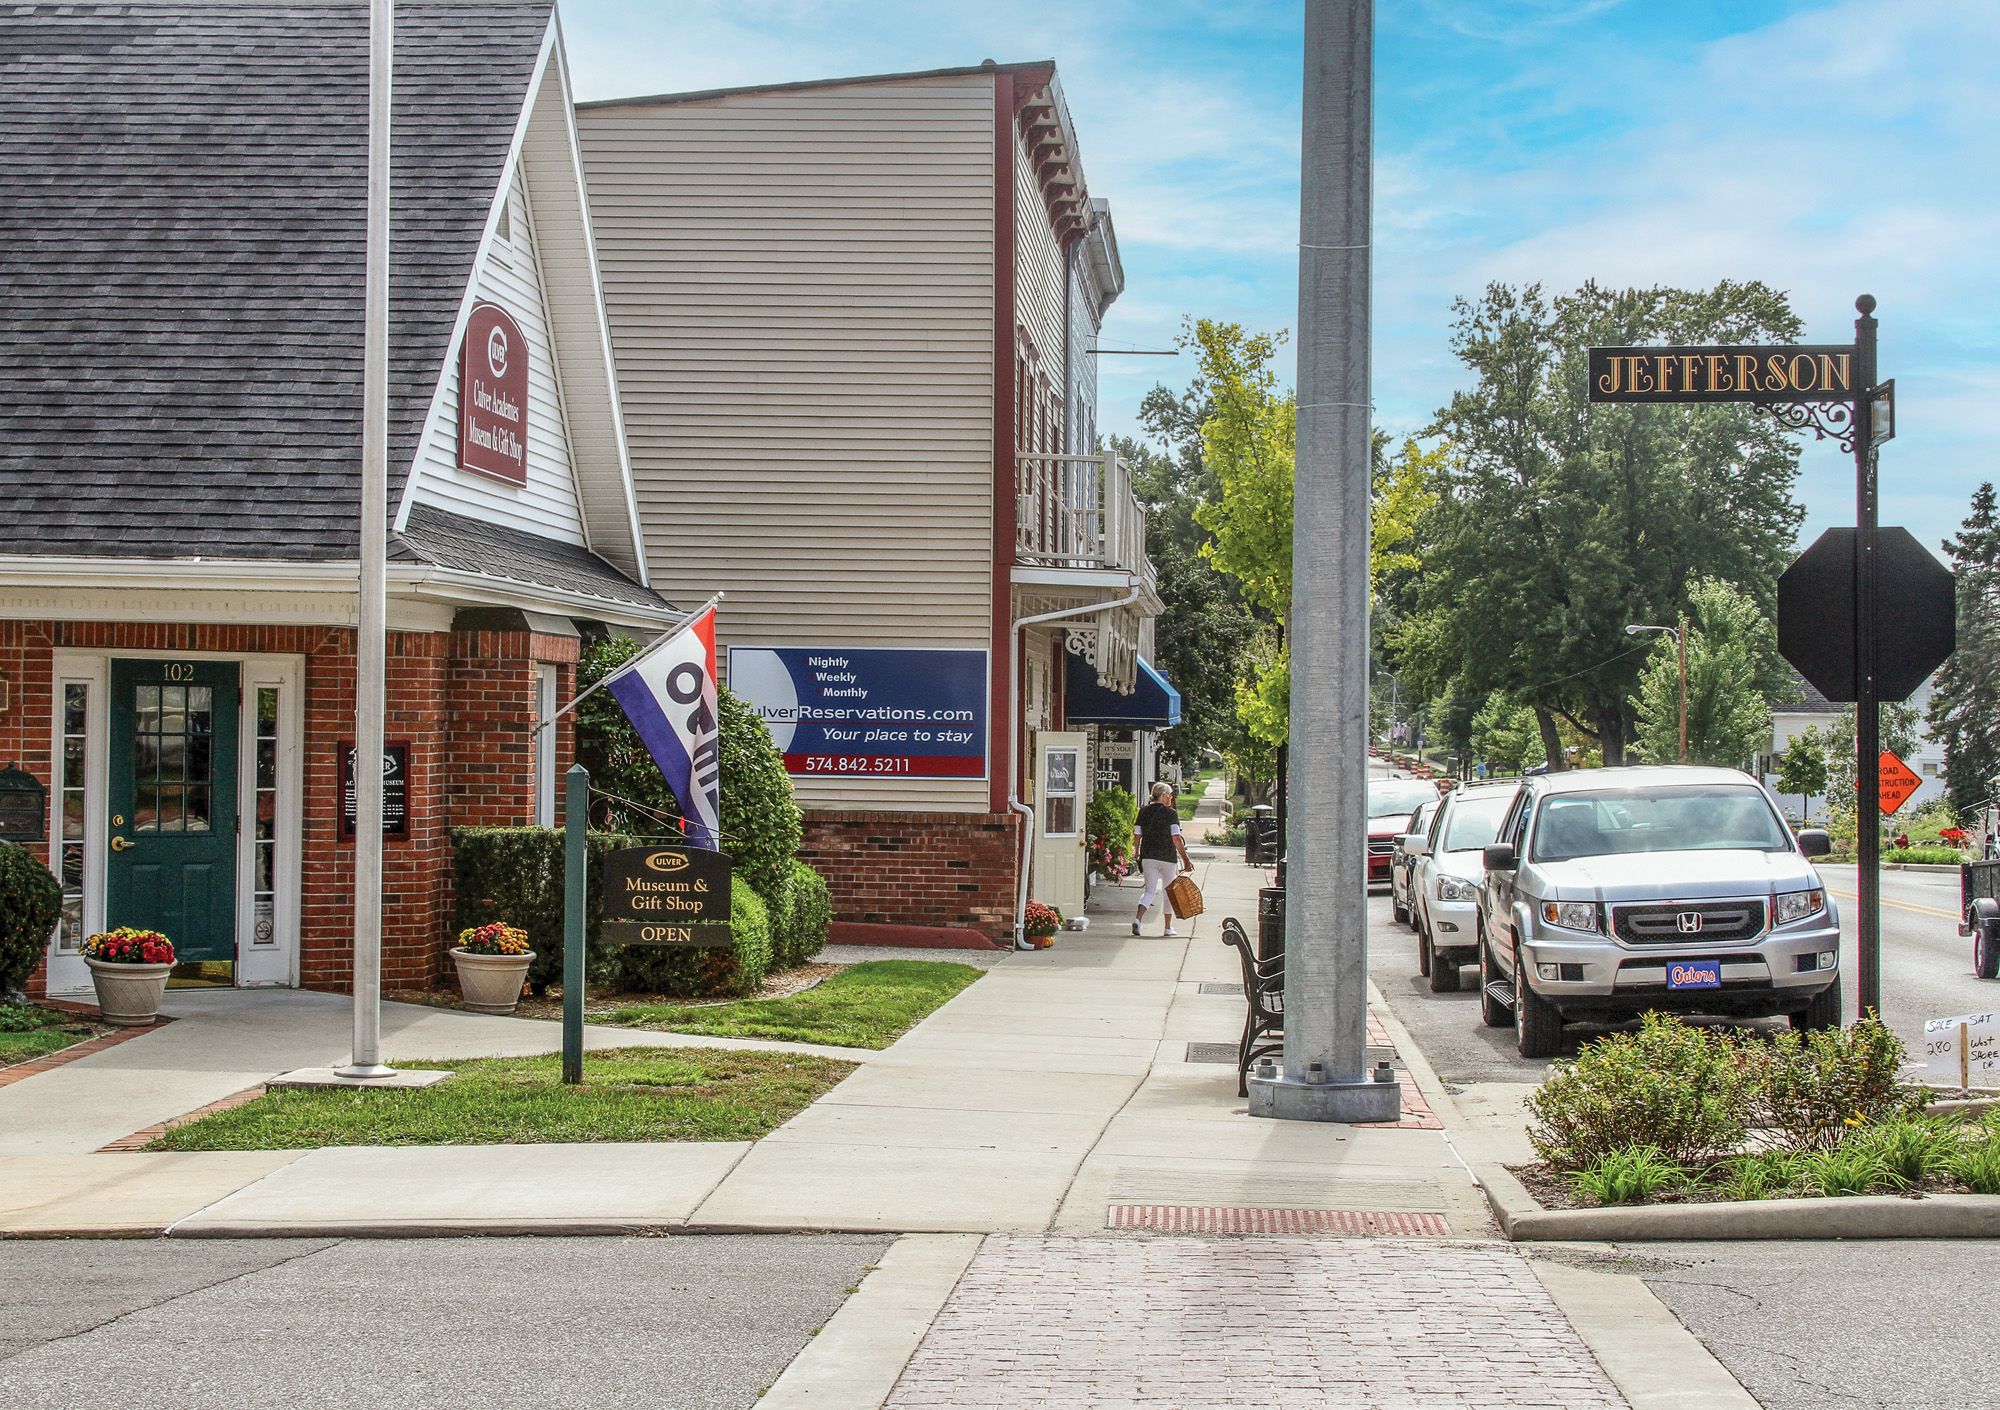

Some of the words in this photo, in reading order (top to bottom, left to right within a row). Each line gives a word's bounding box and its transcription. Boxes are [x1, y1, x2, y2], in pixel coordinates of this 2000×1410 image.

[1598, 354, 1851, 394] JEFFERSON
[473, 379, 492, 411] Culver
[491, 387, 519, 423] Academies
[468, 415, 492, 450] Museum
[492, 424, 498, 452] &
[498, 427, 509, 456] Gift
[509, 431, 523, 467] Shop
[808, 657, 849, 668] Nightly
[163, 663, 194, 681] 102
[816, 672, 857, 684] Weekly
[823, 687, 868, 700] Monthly
[751, 705, 974, 721] ulverReservations.com
[822, 727, 860, 742] Your
[864, 728, 908, 744] place
[912, 729, 931, 742] to
[936, 730, 973, 745] stay
[805, 757, 910, 773] 574.842.5211
[1880, 778, 1915, 788] TRUCTION
[645, 851, 690, 872] CULVER
[625, 877, 690, 892] Museum
[693, 878, 709, 892] &
[631, 895, 662, 910] Gift
[666, 895, 703, 914] Shop
[641, 926, 692, 942] OPEN
[1671, 966, 1716, 985] Gators
[1968, 1013, 1994, 1026] SAT
[1926, 1041, 1952, 1057] 280
